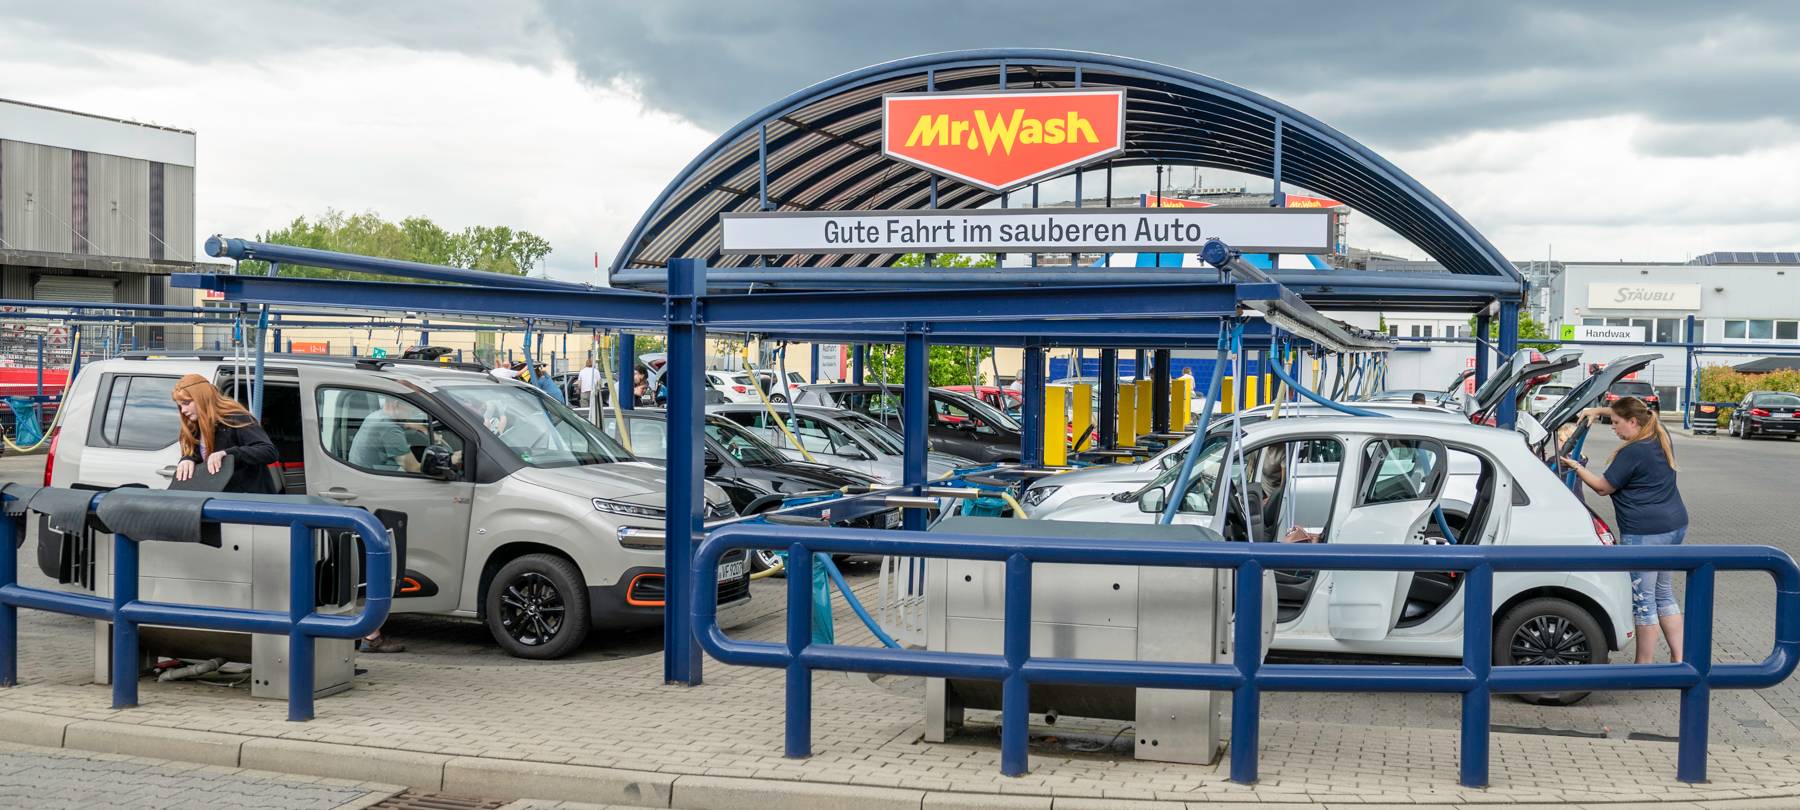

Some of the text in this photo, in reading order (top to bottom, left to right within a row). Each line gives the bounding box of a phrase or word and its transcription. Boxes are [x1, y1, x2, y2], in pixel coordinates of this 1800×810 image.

[824, 217, 1201, 243] Gute Fahrt im sauberen Auto
[1614, 287, 1675, 303] STÄUBLI
[1586, 329, 1631, 338] Handwax
